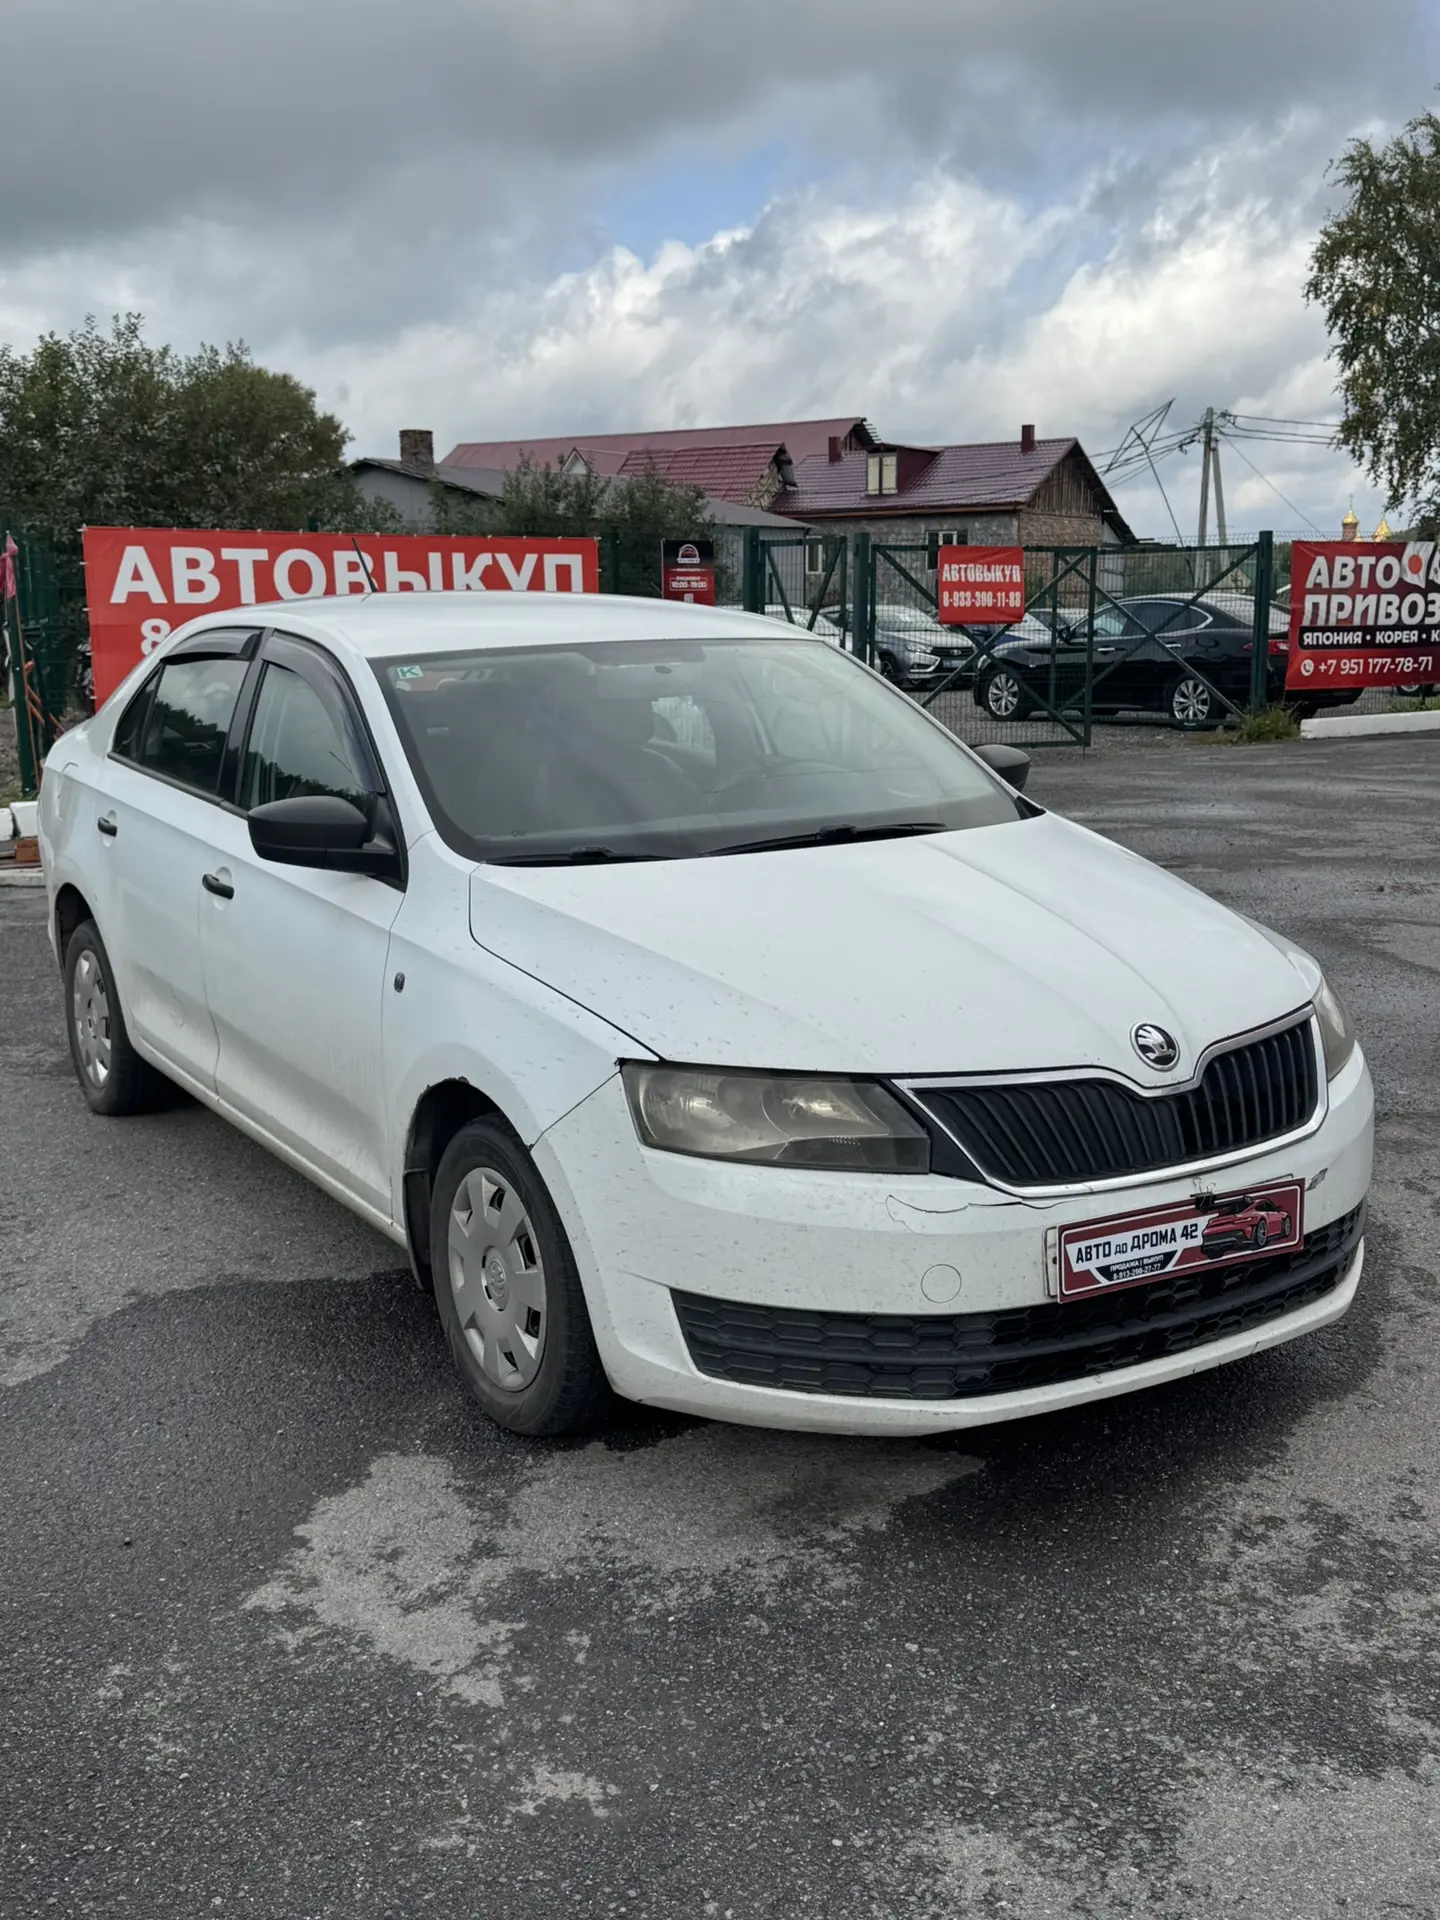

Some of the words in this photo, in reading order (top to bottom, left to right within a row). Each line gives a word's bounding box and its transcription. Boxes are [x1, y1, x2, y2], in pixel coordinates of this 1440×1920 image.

[110, 545, 583, 604] АВТОВЫКУП
[942, 563, 1021, 583] АВТОВЫКУП
[1305, 555, 1400, 589] АВТО
[942, 591, 1021, 607] 8-933-300-11-88
[1302, 592, 1440, 626] ПРИВОЗ
[1303, 631, 1362, 645] ЯПОНИЯ
[1375, 630, 1418, 644] КОРЕЯ
[1319, 660, 1337, 675] +7
[1340, 659, 1363, 675] 951
[1368, 656, 1432, 674] 177-78-71
[1076, 1241, 1111, 1264] АВТО
[1130, 1227, 1177, 1252] ДРОМА
[1181, 1223, 1198, 1240] 42
